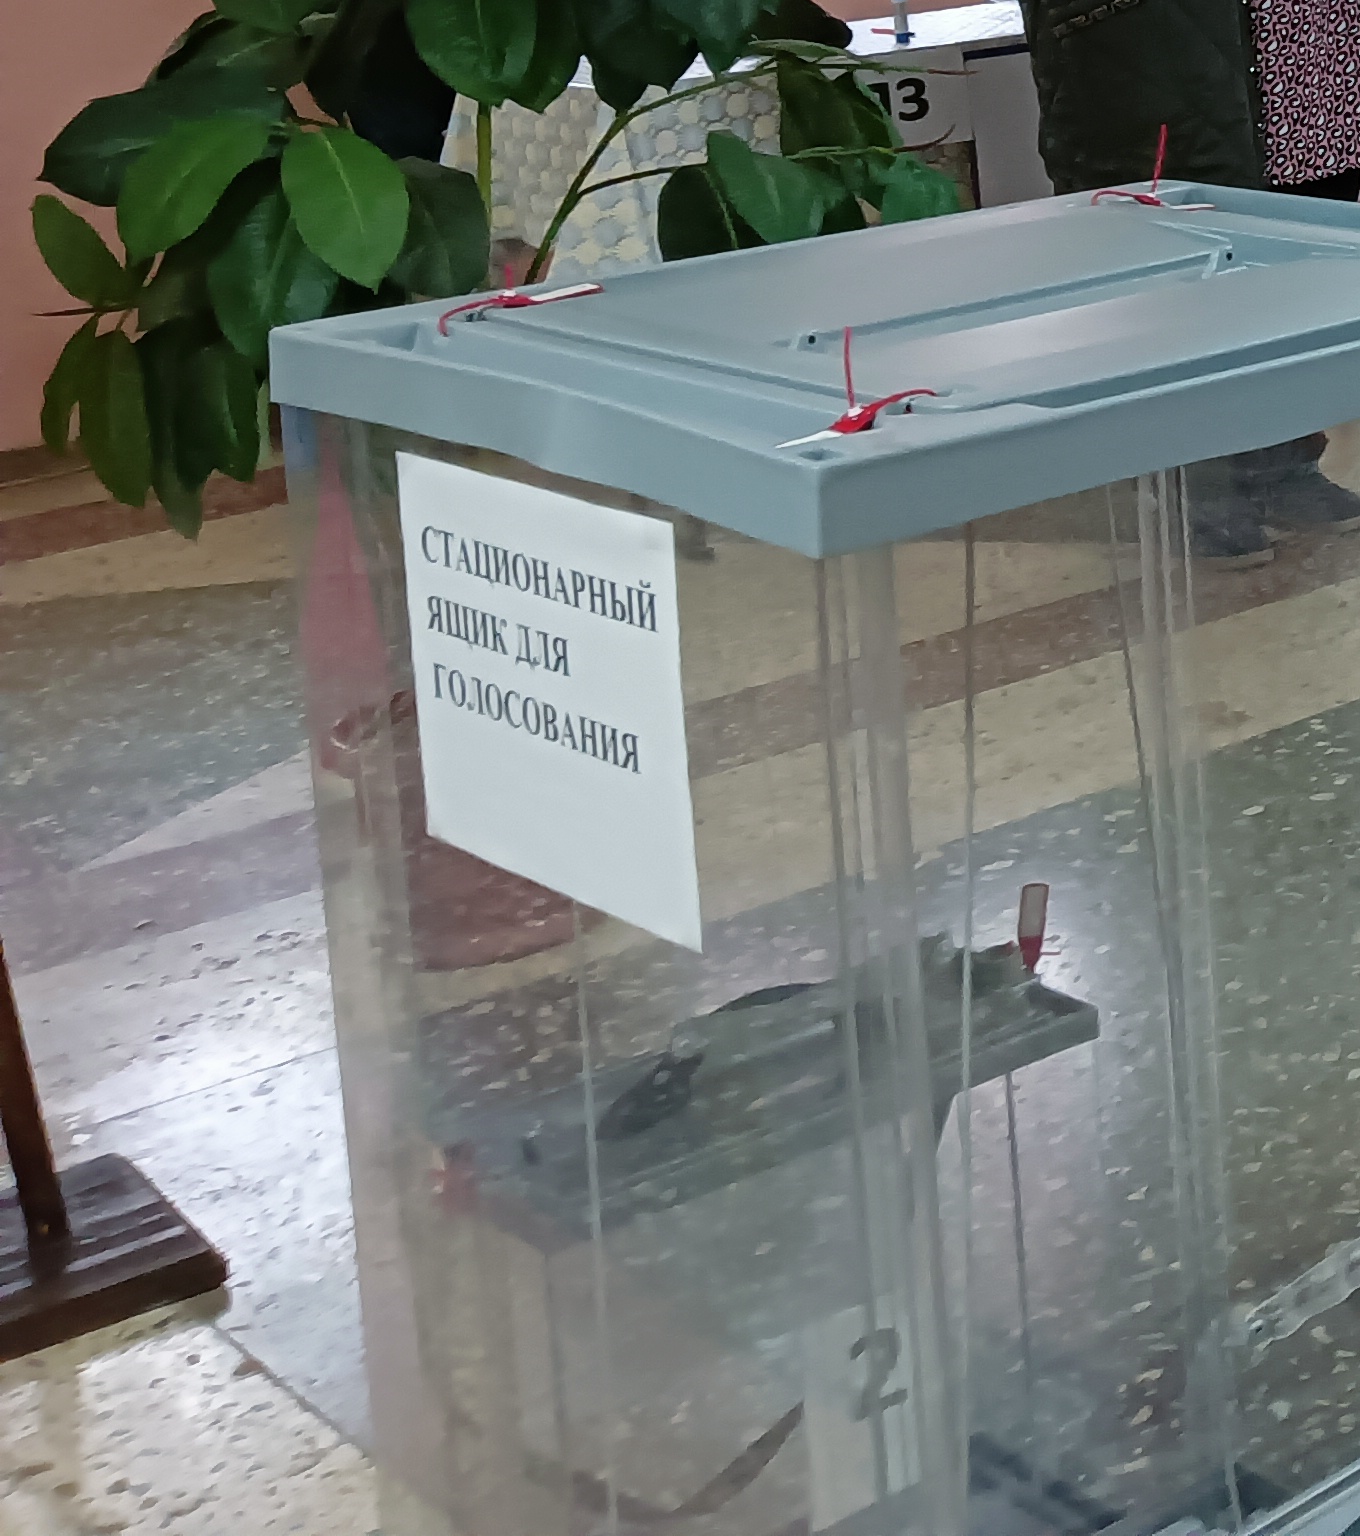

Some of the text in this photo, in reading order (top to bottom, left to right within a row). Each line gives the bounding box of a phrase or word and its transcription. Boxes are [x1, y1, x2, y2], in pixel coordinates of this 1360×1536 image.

[420, 525, 659, 633] СТАЦИОНАРНЫЙ
[426, 595, 571, 677] ЯЩИК ДЛЯ
[433, 663, 642, 774] ГОЛОСОВАНИЯ
